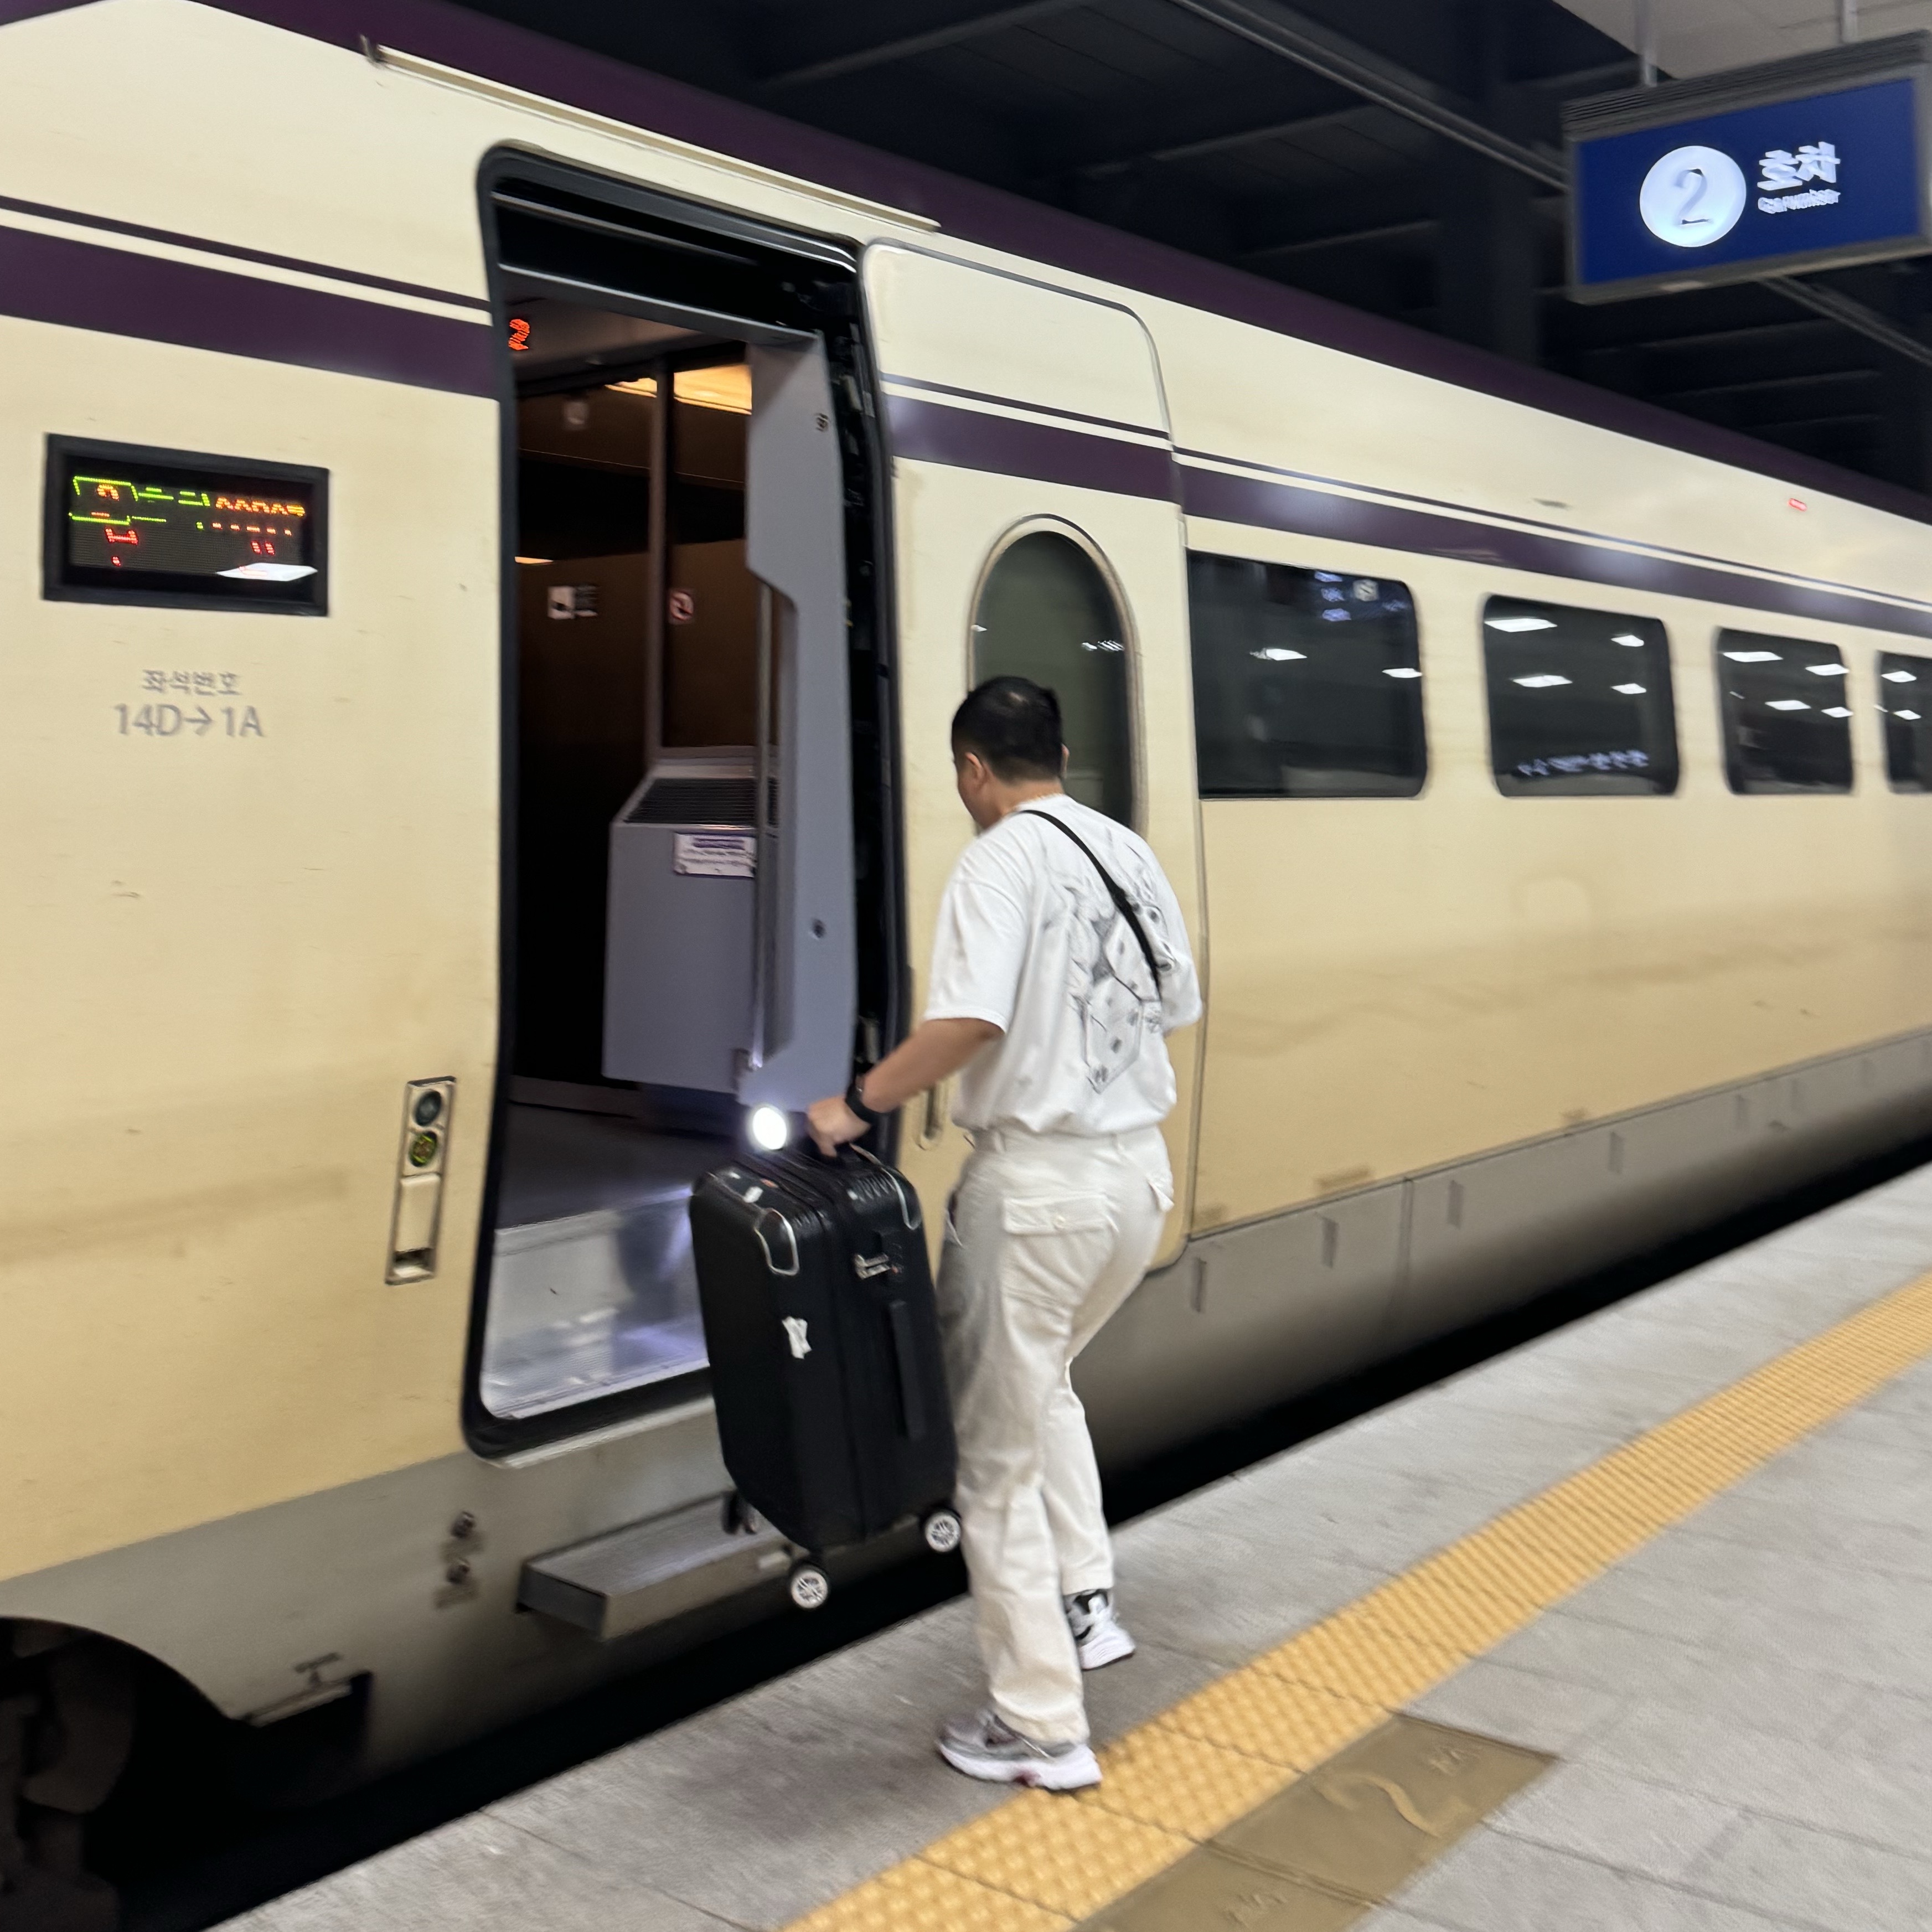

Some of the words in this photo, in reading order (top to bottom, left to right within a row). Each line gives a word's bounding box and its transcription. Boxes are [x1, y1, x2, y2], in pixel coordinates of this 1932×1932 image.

[1673, 168, 1715, 225] 2
[508, 318, 530, 351] 2
[141, 669, 242, 696] 좌석번호
